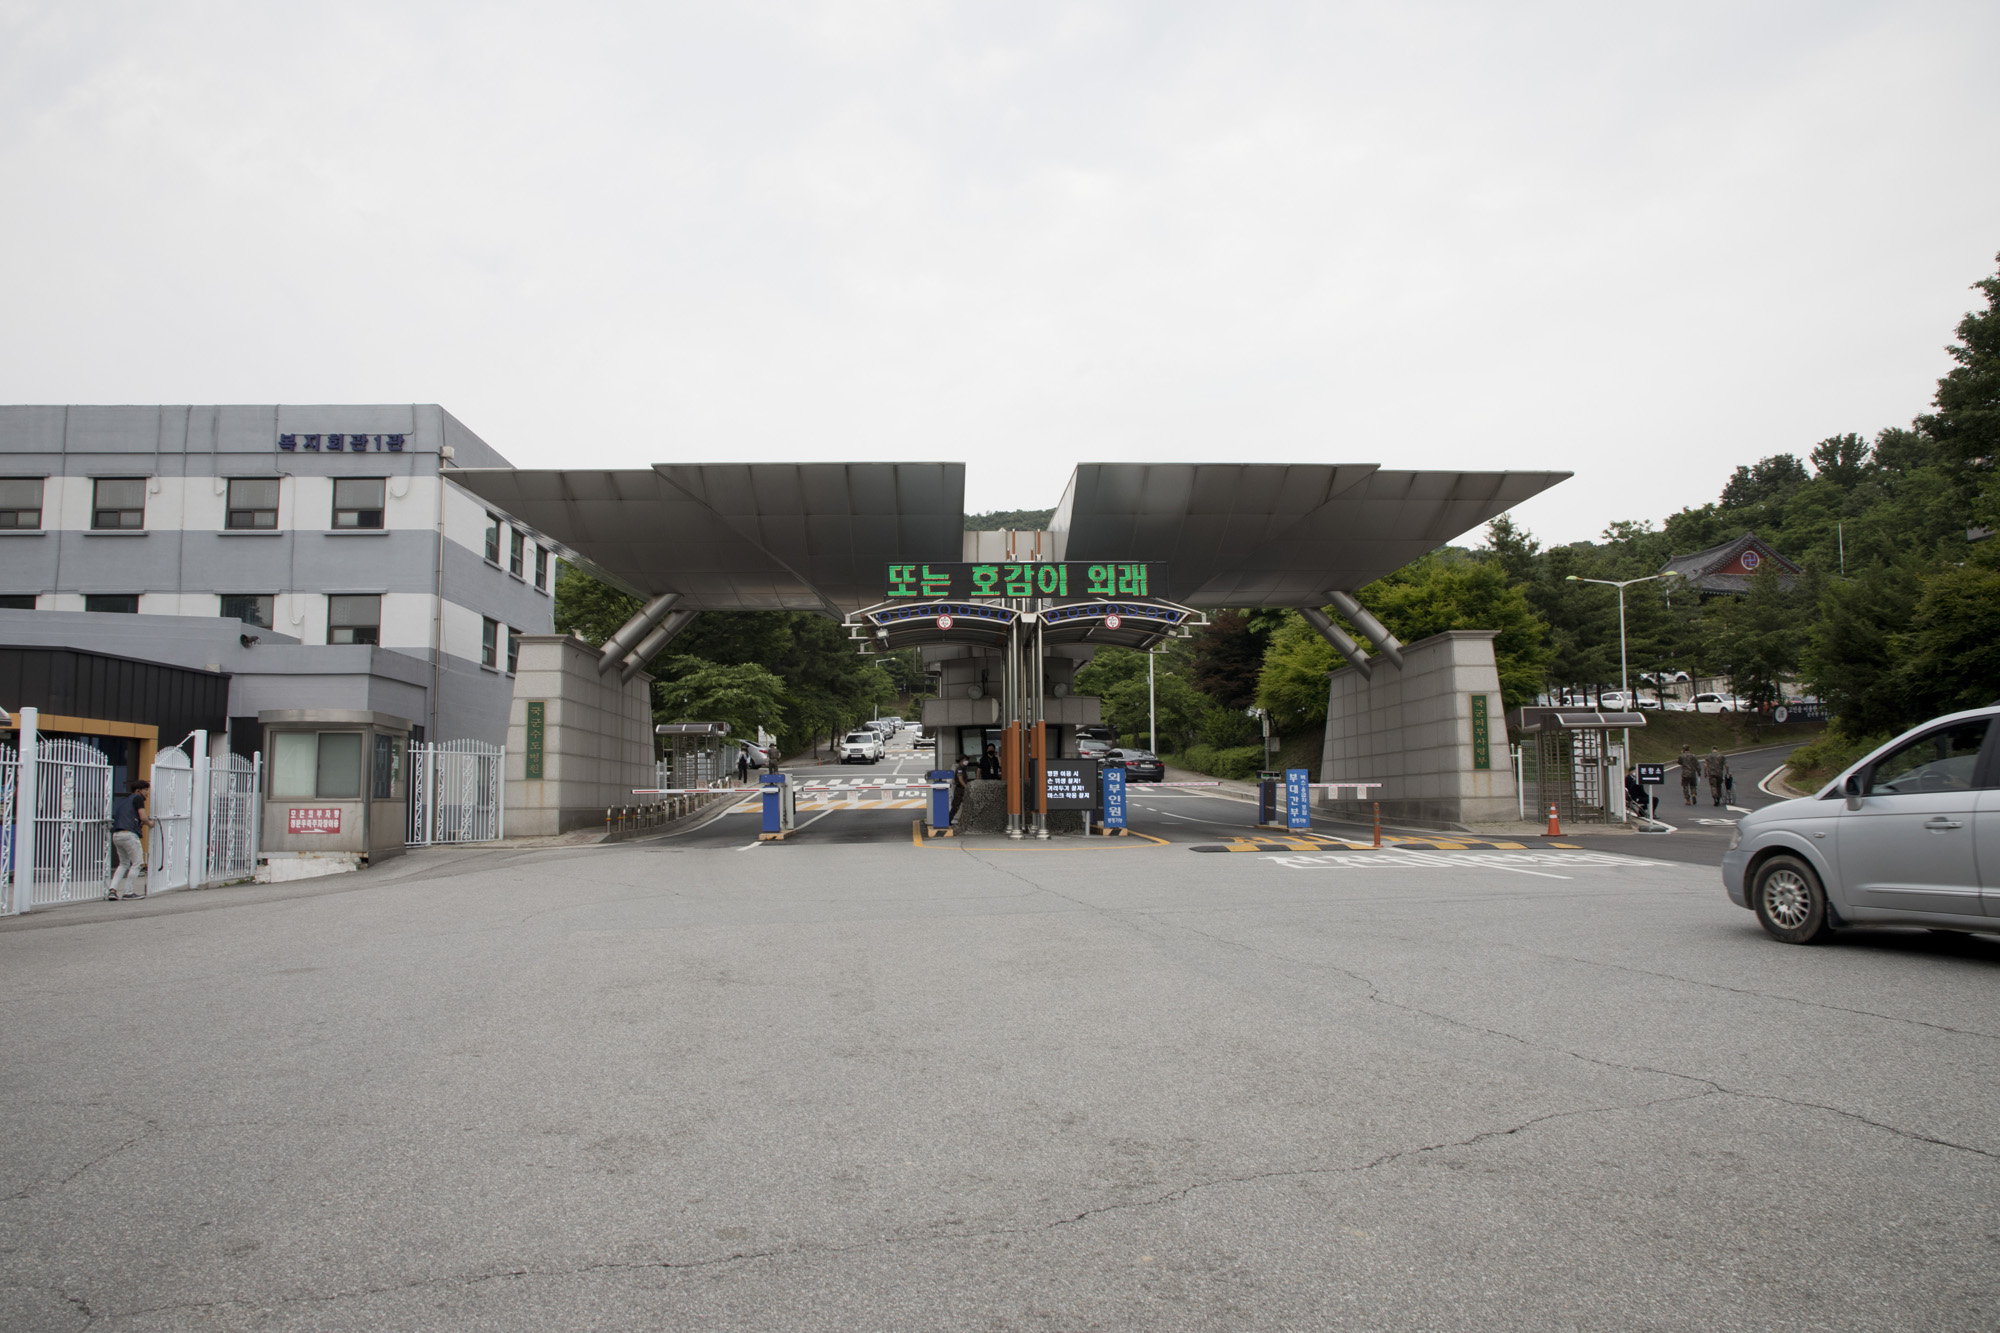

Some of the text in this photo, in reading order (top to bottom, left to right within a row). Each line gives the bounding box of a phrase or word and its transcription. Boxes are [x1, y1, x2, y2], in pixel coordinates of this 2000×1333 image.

[278, 433, 405, 452] 복지회관1관
[887, 564, 1148, 597] 또는 호감이 외래
[529, 706, 542, 774] 국군수도병원
[1108, 772, 1121, 817] 외부인원
[1289, 773, 1299, 817] 부대간부
